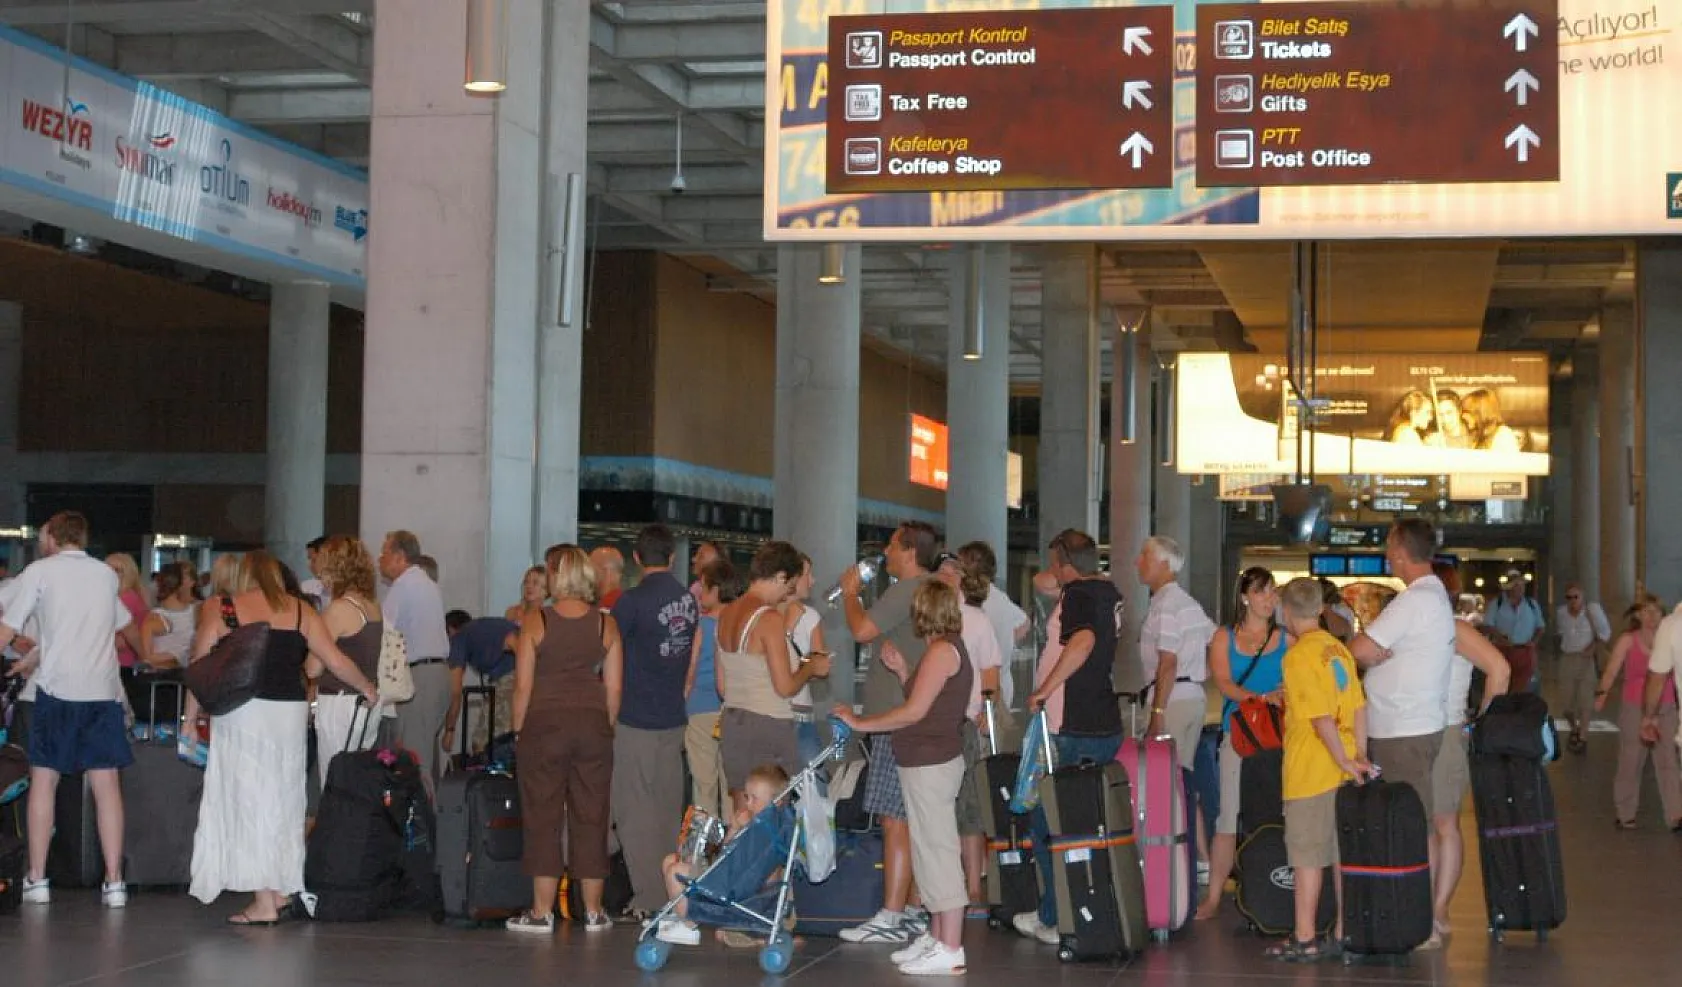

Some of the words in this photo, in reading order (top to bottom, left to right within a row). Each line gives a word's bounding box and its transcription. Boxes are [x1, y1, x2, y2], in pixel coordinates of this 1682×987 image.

[890, 29, 964, 48] Pasaport
[969, 26, 1028, 43] Kontrol
[1261, 18, 1300, 36] Bilet
[1304, 17, 1348, 37] Satış
[889, 50, 967, 69] Passport
[971, 48, 1036, 66] Control
[1260, 41, 1332, 59] Tickets
[1589, 43, 1663, 72] world!
[1261, 72, 1342, 92] Hediyelik
[1347, 71, 1391, 92] Eşya
[889, 94, 921, 111] Tax
[927, 93, 968, 110] Free
[1261, 94, 1308, 112] Gifts
[22, 98, 93, 151] WEZYR
[889, 136, 968, 155] Kafeterya
[1261, 127, 1301, 145] PTT
[888, 158, 949, 175] Coffee
[955, 156, 1001, 176] Shop
[1261, 150, 1304, 168] Post
[1312, 149, 1371, 167] Office
